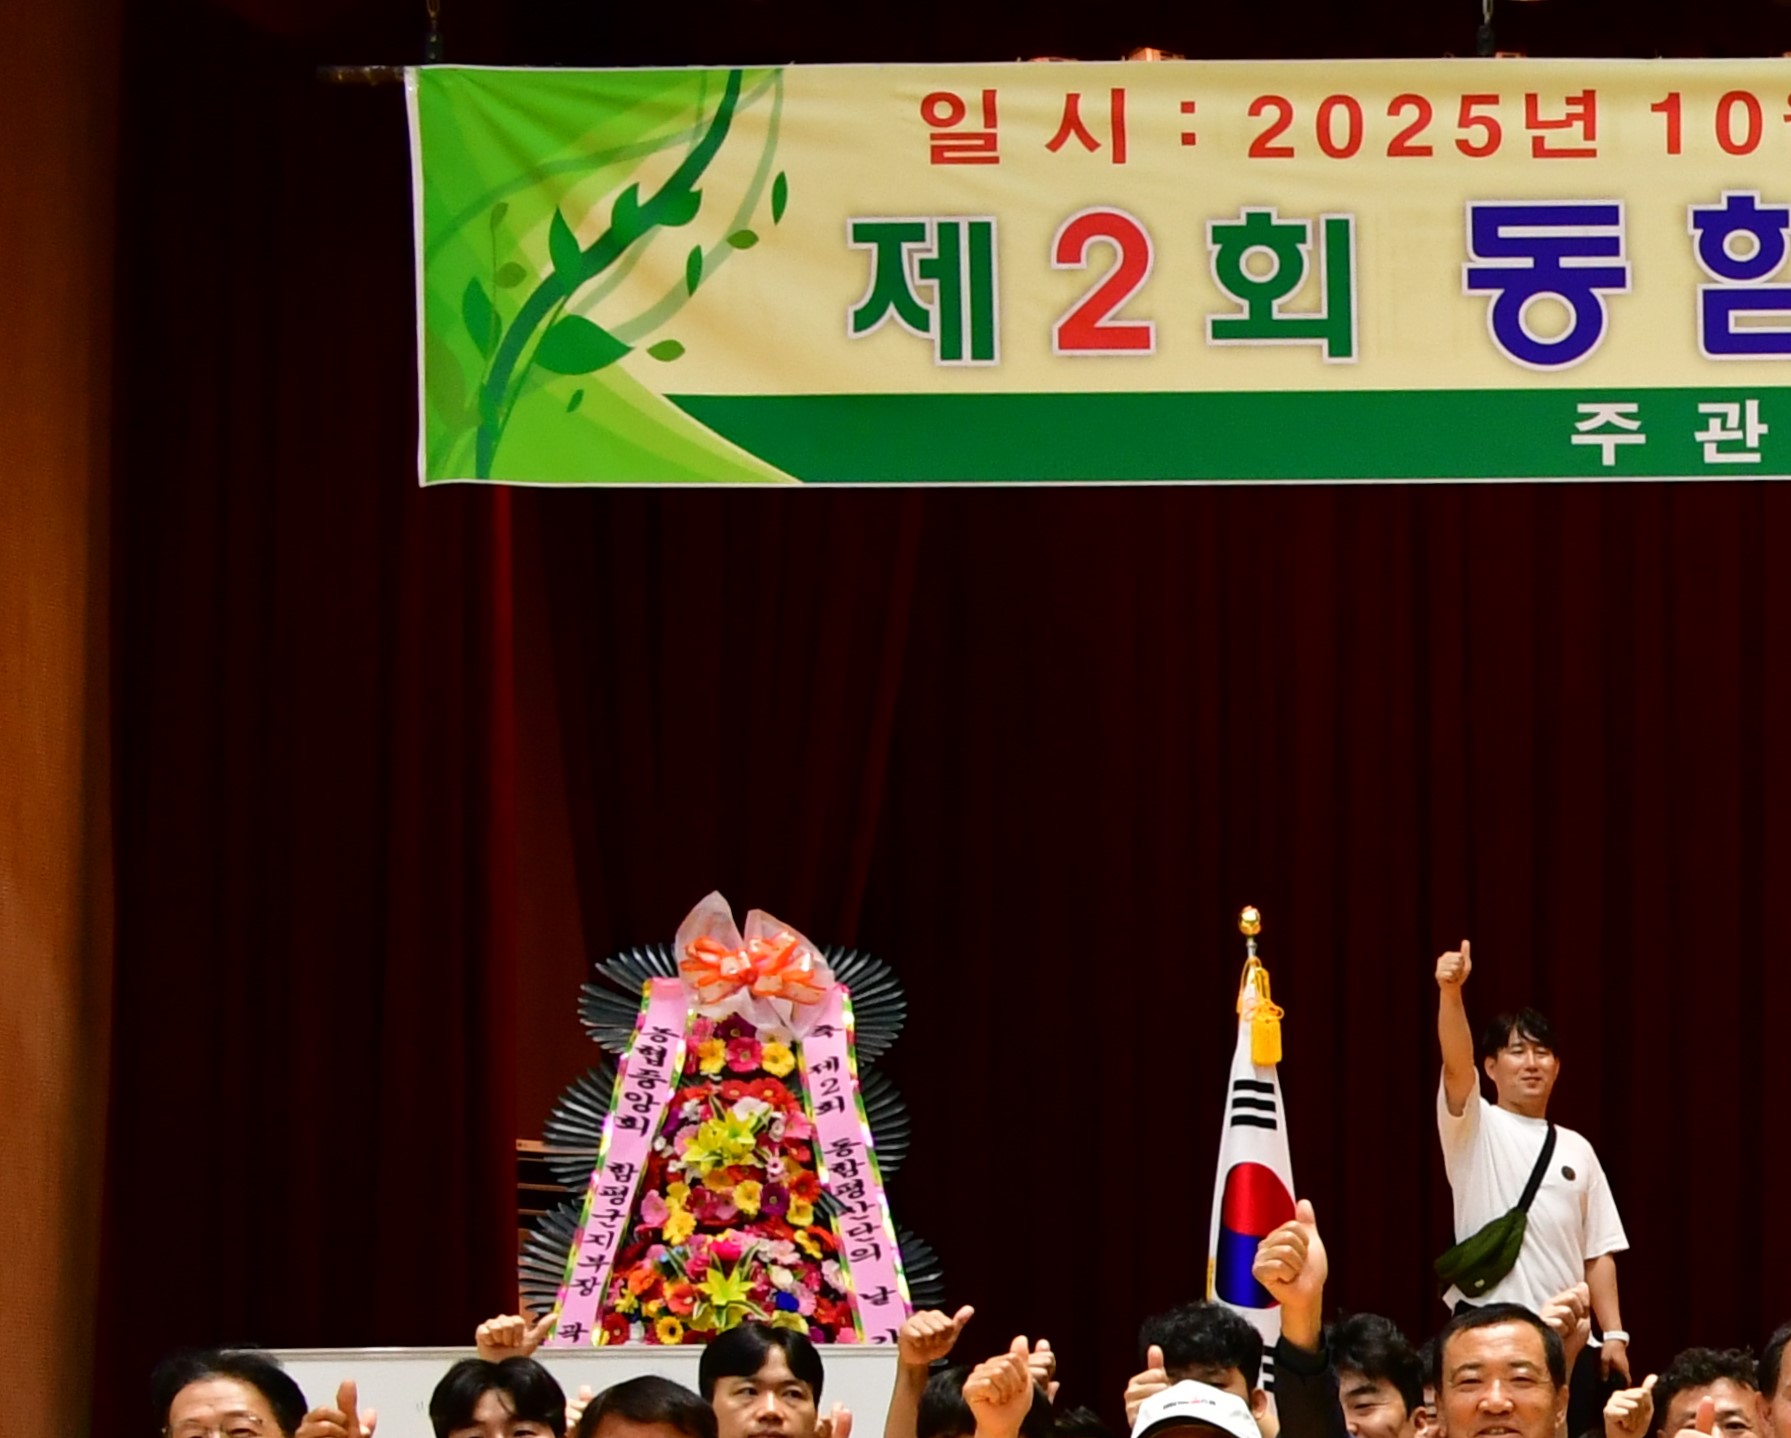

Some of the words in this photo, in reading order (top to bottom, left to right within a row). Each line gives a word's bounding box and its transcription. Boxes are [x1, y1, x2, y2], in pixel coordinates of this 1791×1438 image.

[1248, 89, 1597, 159] 2025년
[853, 213, 1351, 360] 제2회
[613, 1026, 679, 1137] 농협중앙회
[808, 1056, 846, 1116] 제2회
[569, 1161, 639, 1297] 함평군지부장
[824, 1138, 882, 1264] 동함평산단의
[859, 1287, 896, 1307] 날
